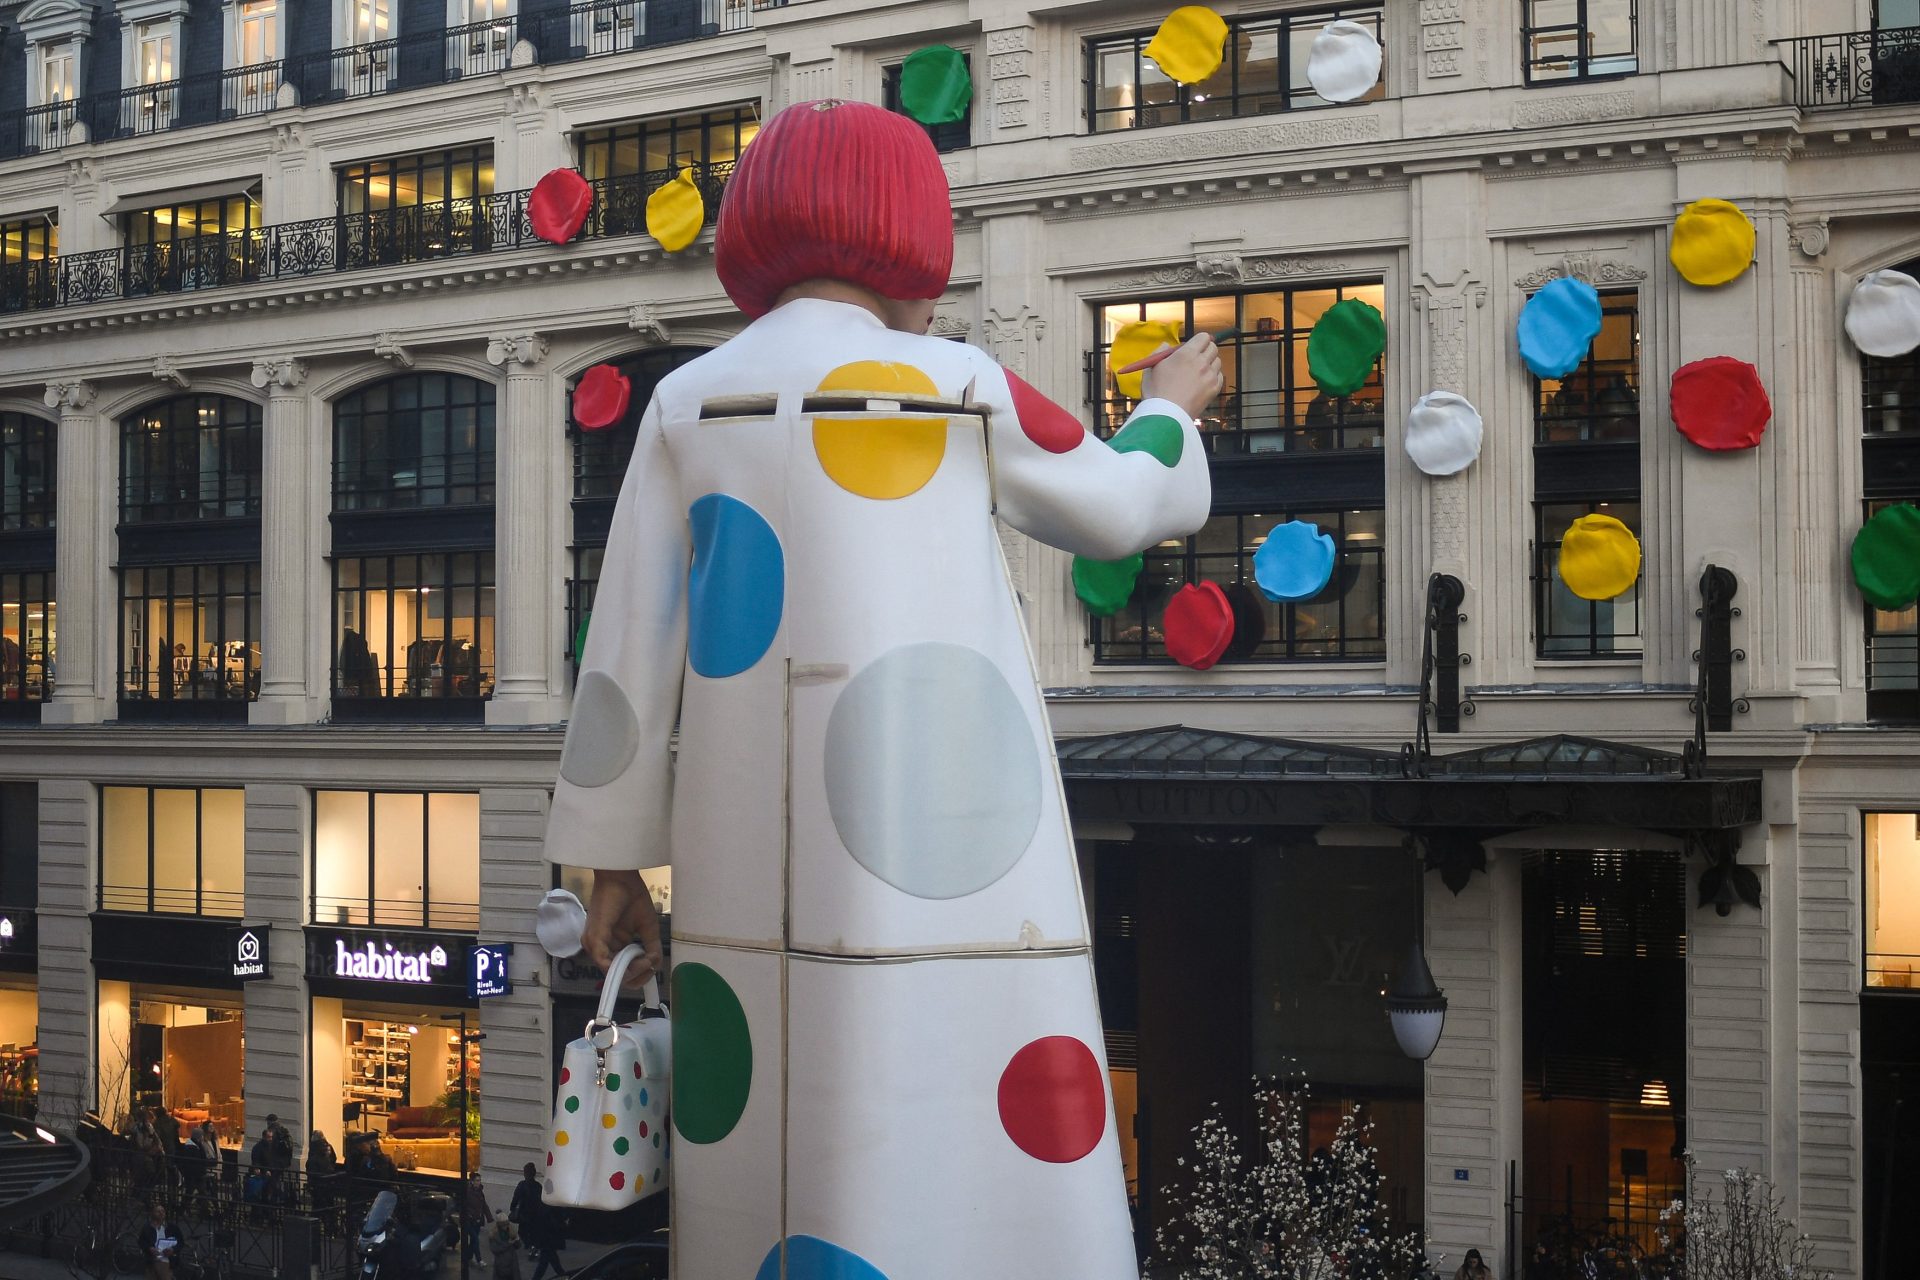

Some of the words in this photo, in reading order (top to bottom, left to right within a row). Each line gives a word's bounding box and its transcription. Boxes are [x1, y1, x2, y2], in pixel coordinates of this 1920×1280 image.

[1111, 785, 1282, 815] VUITTON
[233, 963, 264, 976] habitat
[336, 940, 431, 982] habitat
[476, 953, 489, 980] P
[476, 980, 493, 989] Rivoli
[476, 985, 504, 995] Pont-Neuf
